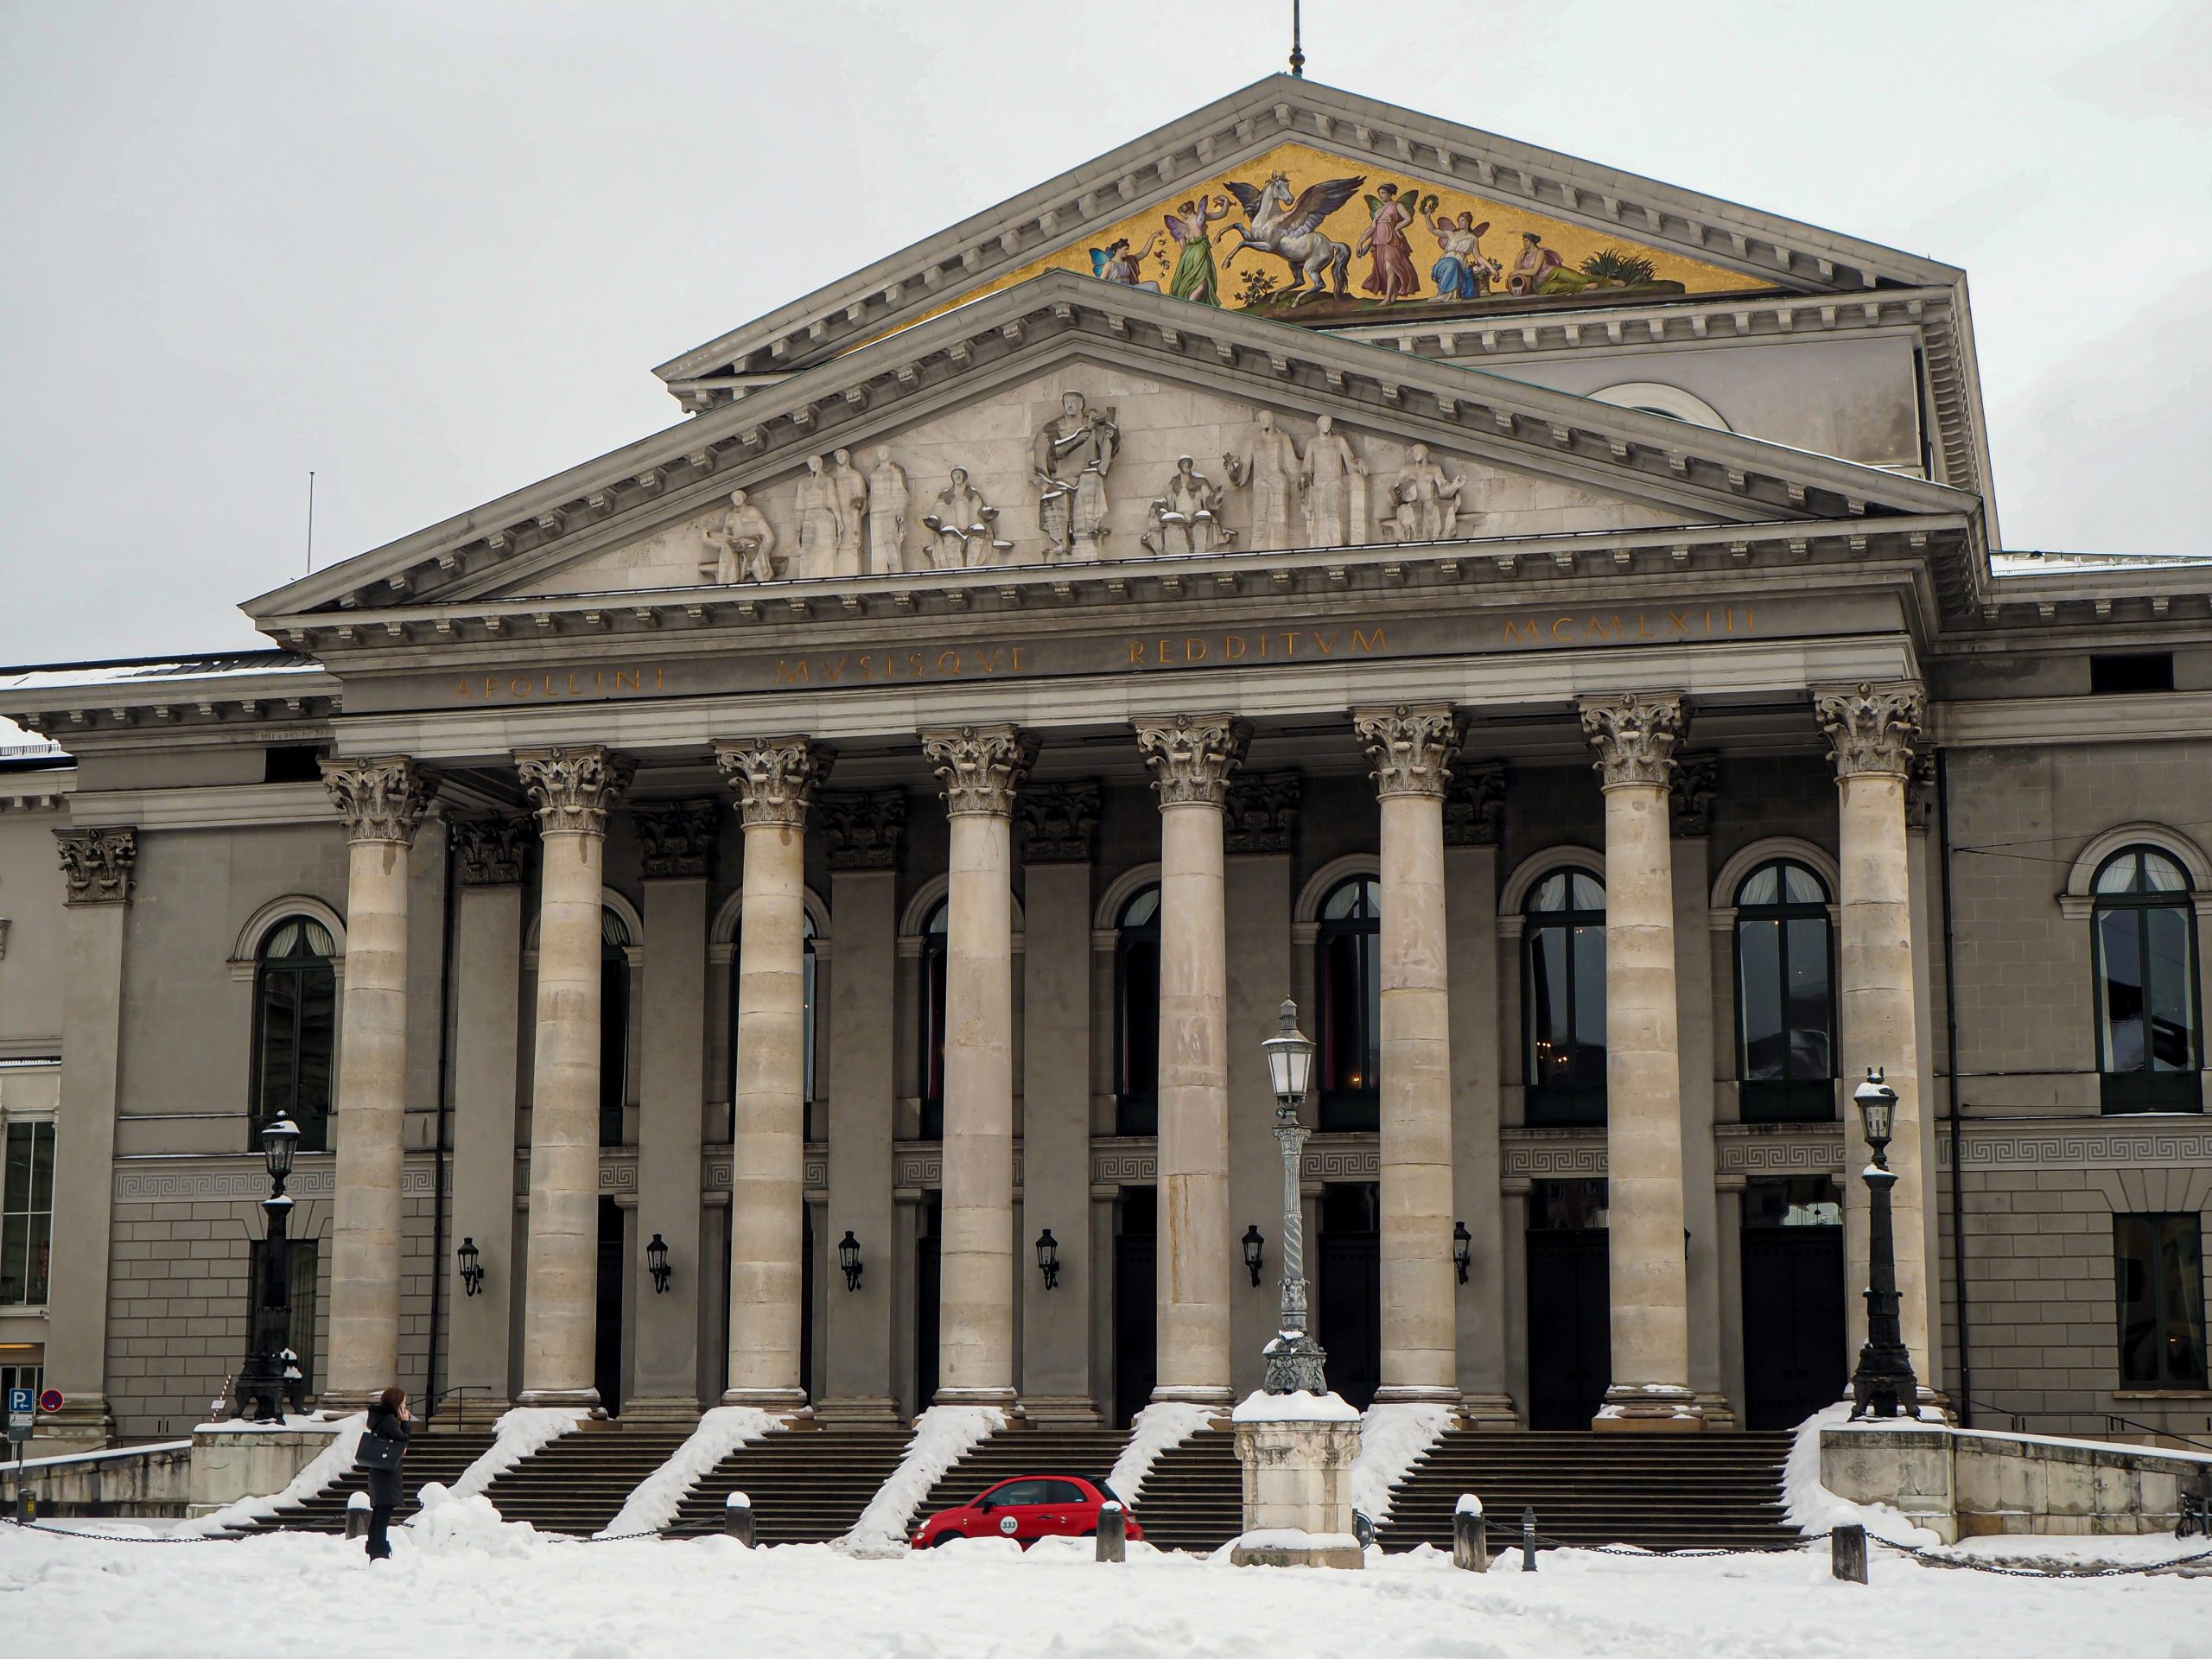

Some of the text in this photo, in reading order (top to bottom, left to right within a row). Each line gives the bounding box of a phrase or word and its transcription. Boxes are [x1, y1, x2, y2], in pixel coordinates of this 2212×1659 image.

[452, 607, 1755, 702] APOLLINI MVSISQVE REDDITVM MCMLXIII
[13, 1391, 26, 1408] P
